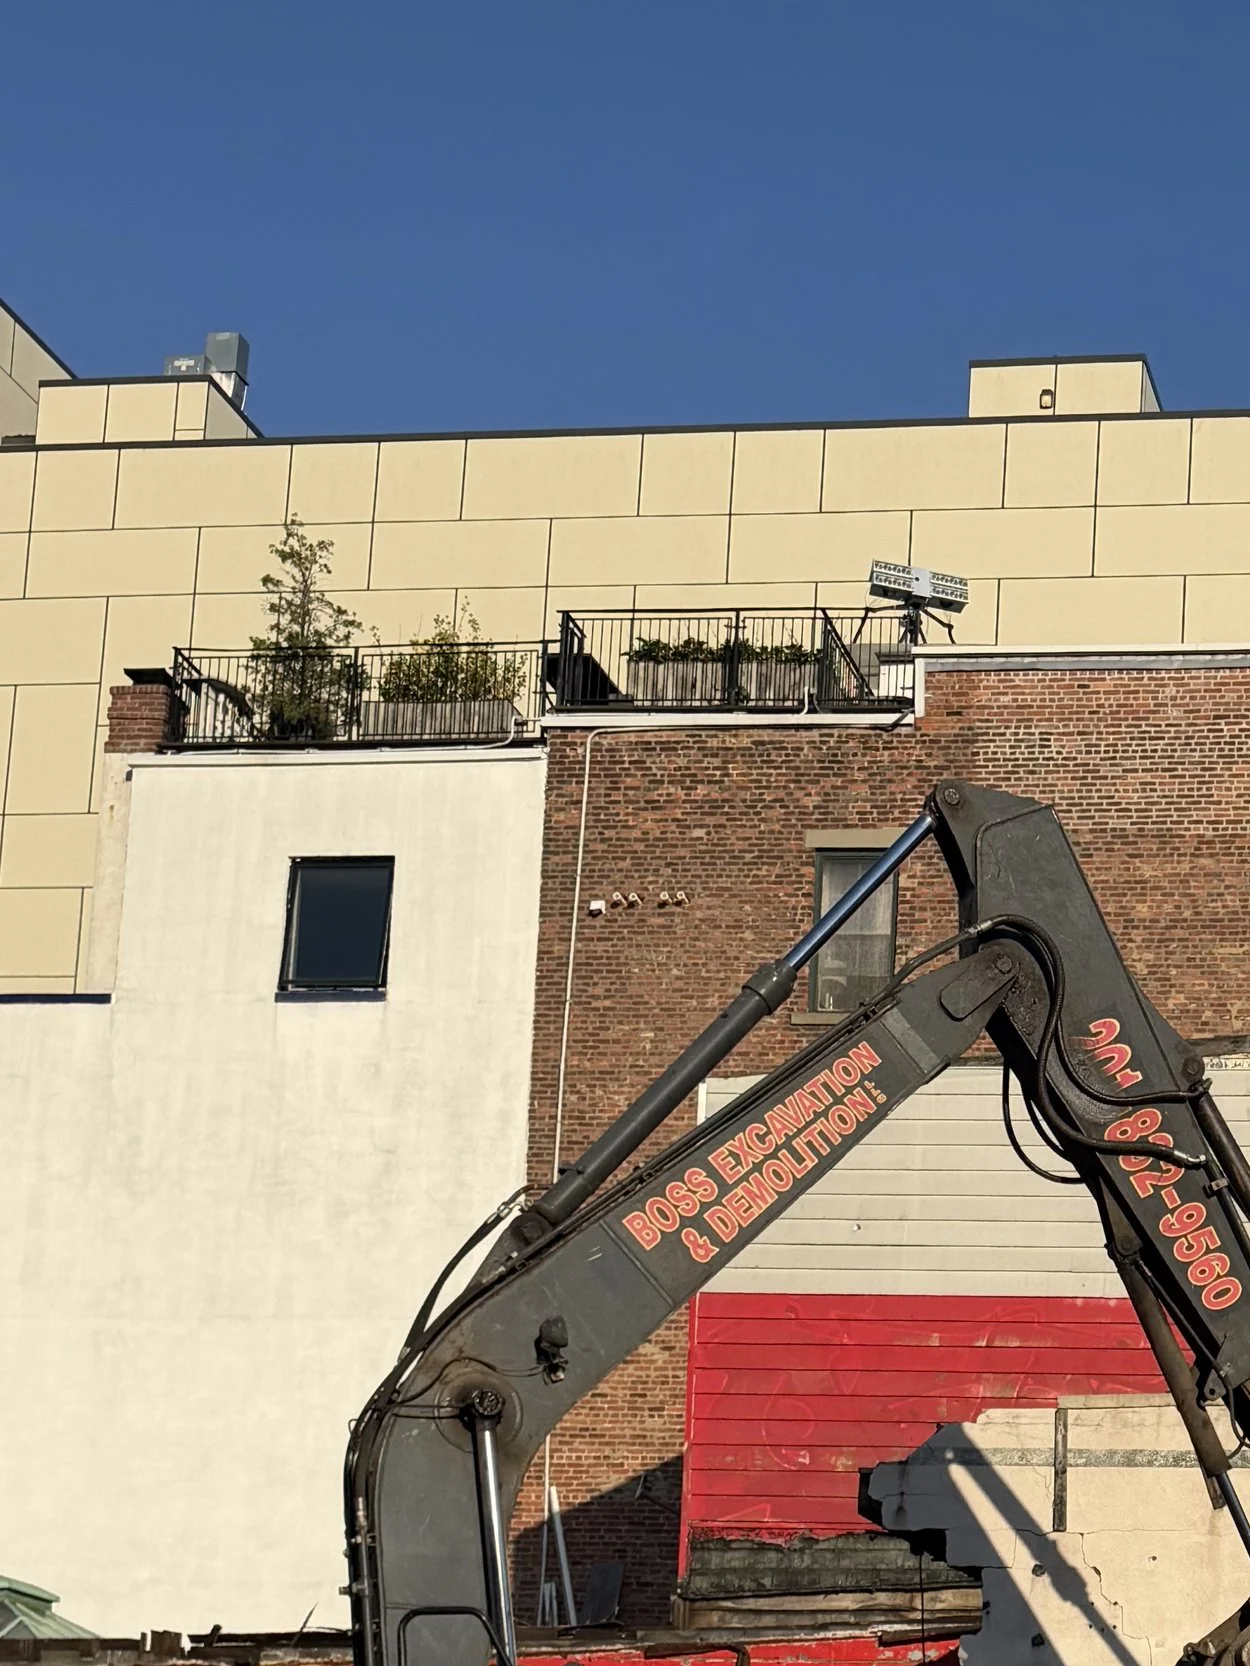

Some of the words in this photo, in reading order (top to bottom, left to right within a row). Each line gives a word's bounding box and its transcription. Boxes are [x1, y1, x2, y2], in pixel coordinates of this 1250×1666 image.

[622, 1167, 718, 1251] BOSS
[708, 1040, 882, 1184] EXCAVATION
[681, 1227, 719, 1263] &
[703, 1089, 877, 1243] DEMOLITION
